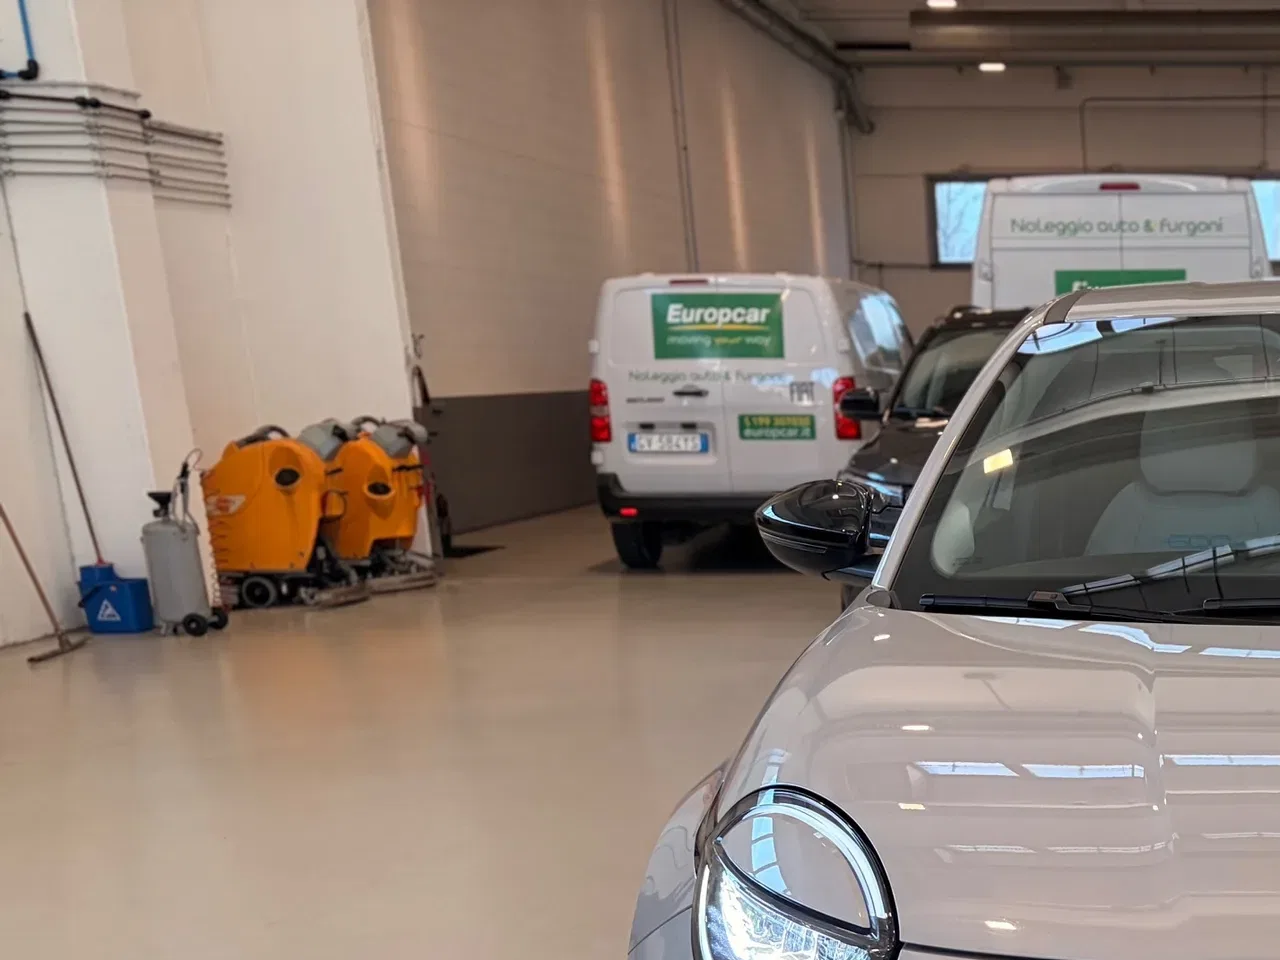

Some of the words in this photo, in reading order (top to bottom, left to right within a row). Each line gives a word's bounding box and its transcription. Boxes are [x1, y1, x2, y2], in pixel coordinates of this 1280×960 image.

[1010, 218, 1093, 237] Noleggio
[1097, 219, 1140, 233] auto
[1143, 219, 1156, 233] &
[1159, 216, 1223, 237] furgoni
[667, 303, 771, 328] Europcar
